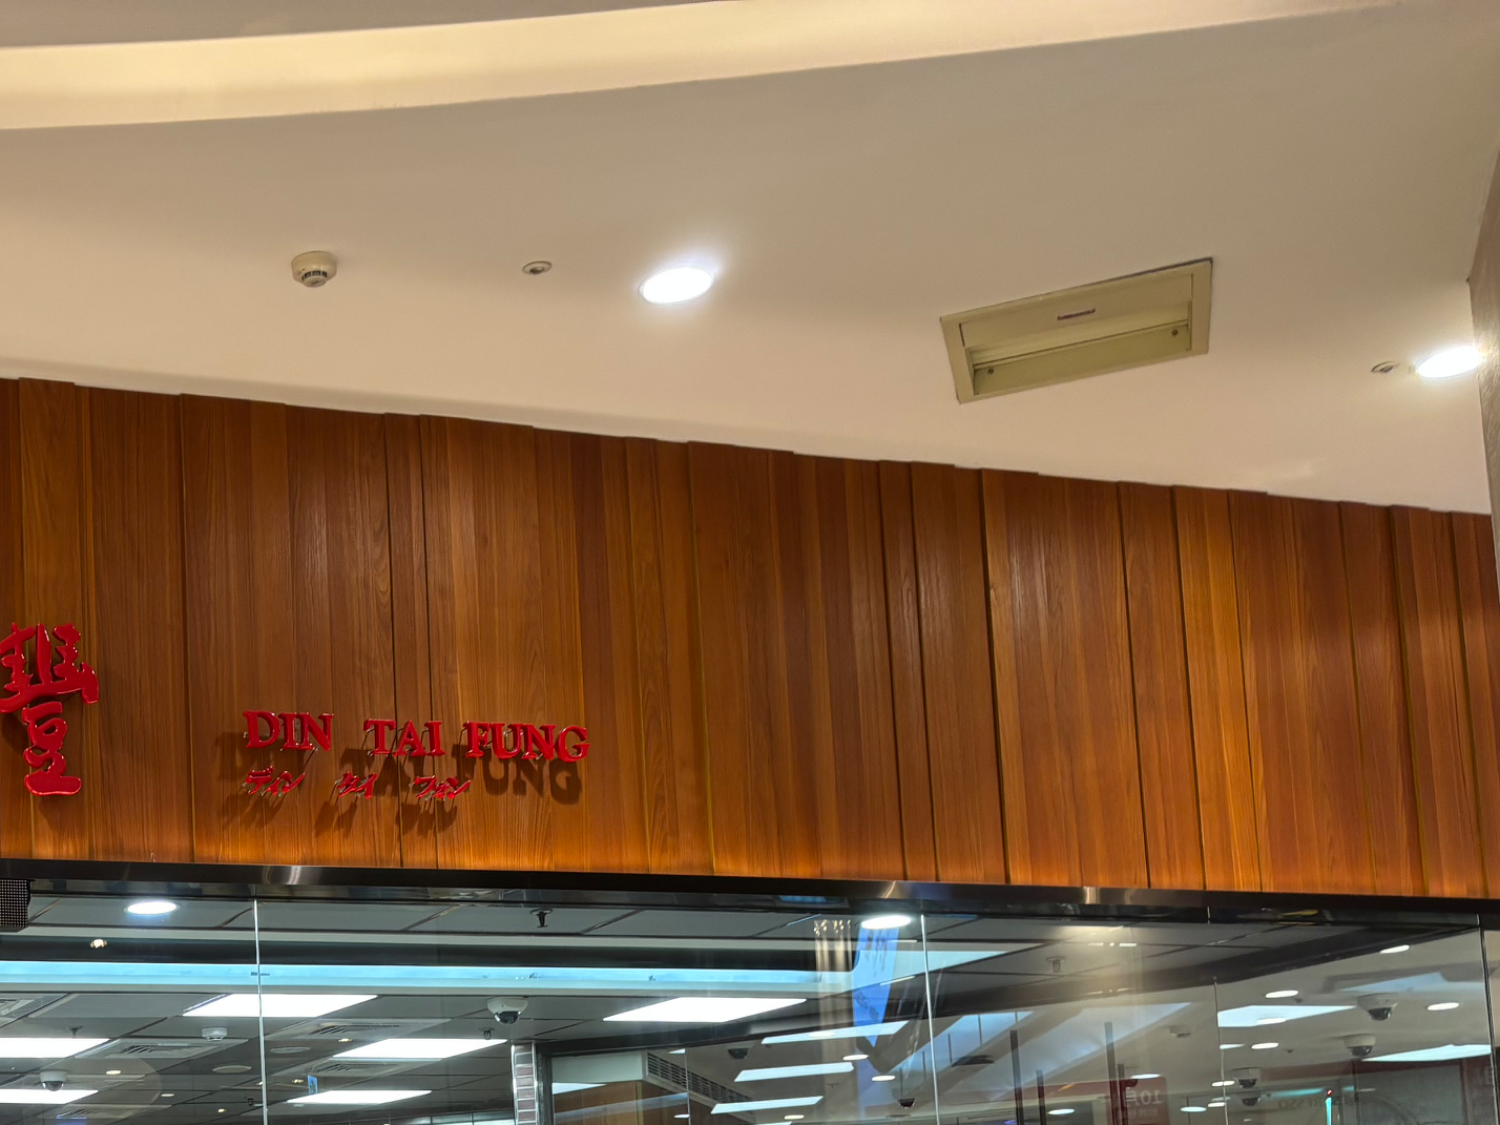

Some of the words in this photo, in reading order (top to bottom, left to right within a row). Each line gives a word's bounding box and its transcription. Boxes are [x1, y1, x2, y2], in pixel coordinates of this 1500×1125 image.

[242, 710, 334, 751] DIN
[363, 718, 446, 757] TAI
[463, 720, 591, 763] FUNG
[334, 770, 378, 800] タイ
